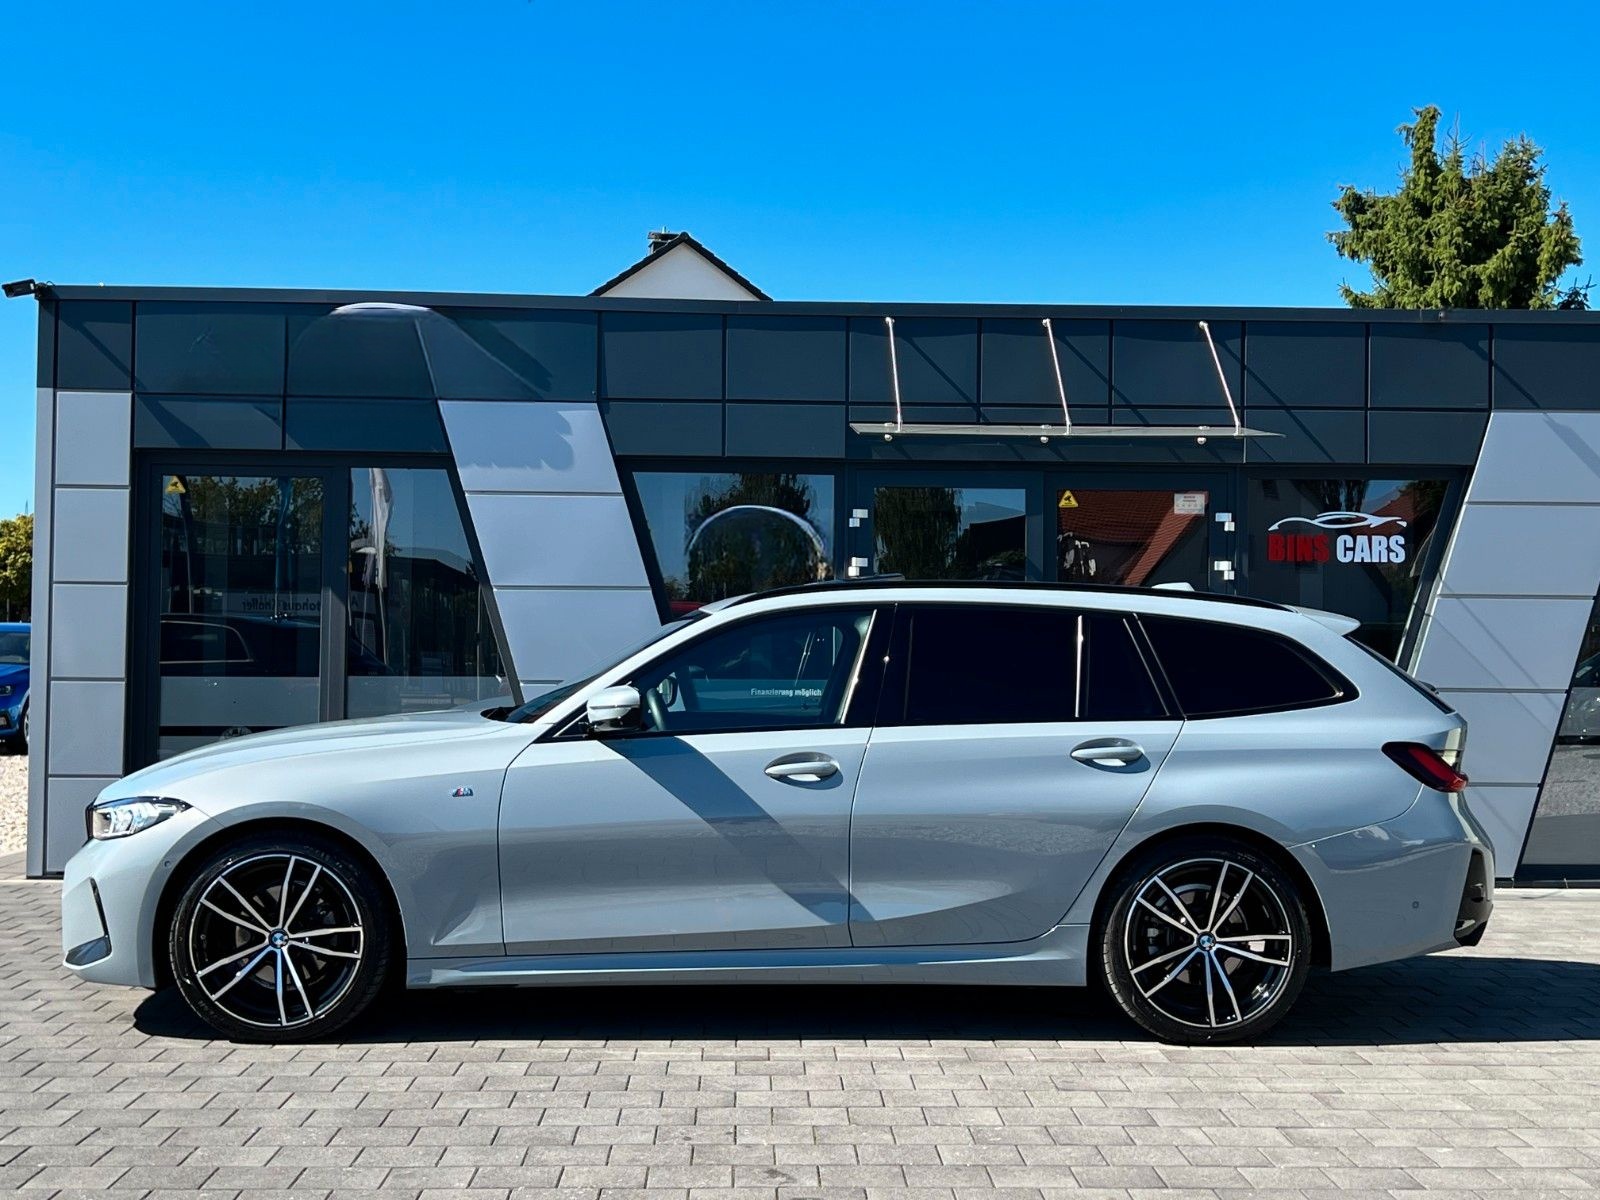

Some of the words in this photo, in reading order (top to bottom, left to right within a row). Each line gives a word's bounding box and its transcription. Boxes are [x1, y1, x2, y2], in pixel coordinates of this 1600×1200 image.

[1267, 533, 1330, 562] BINS
[1336, 534, 1406, 563] CARS
[750, 687, 793, 697] Finanzierung
[795, 687, 822, 697] möglich
